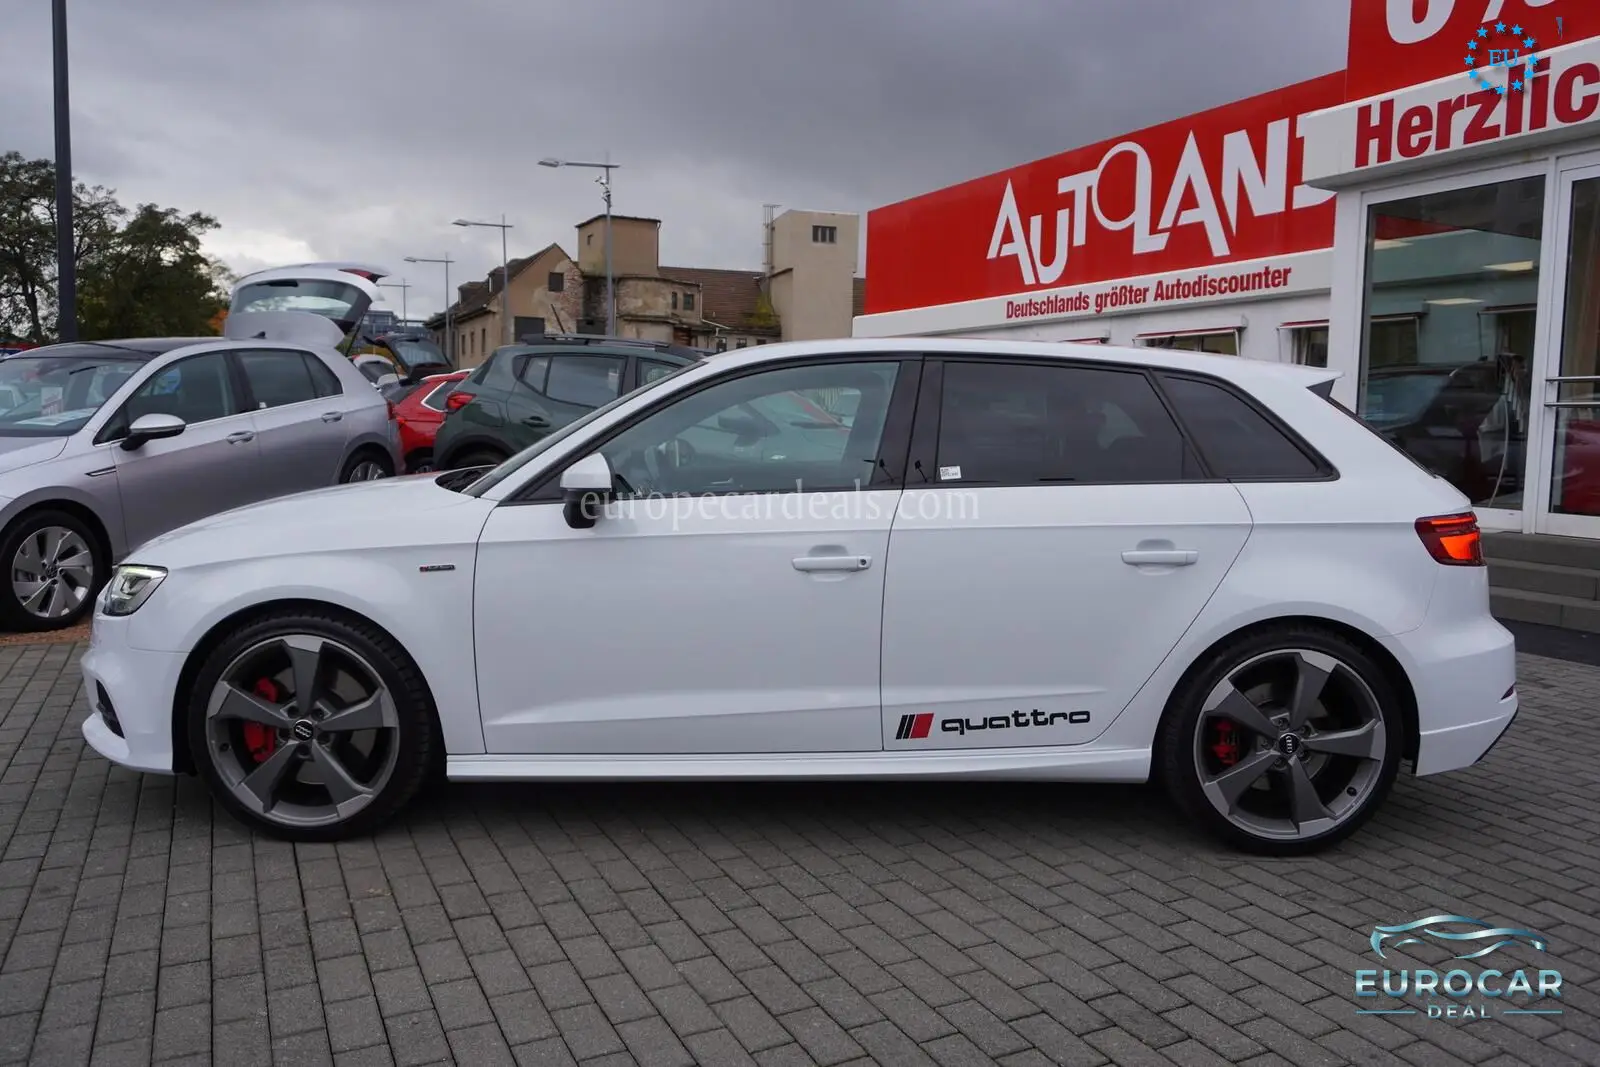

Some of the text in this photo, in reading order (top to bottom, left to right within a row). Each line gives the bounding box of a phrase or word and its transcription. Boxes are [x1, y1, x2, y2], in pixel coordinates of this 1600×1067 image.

[1006, 266, 1292, 319] Deutschlands größter Autodiscounter
[941, 709, 1091, 735] quattro
